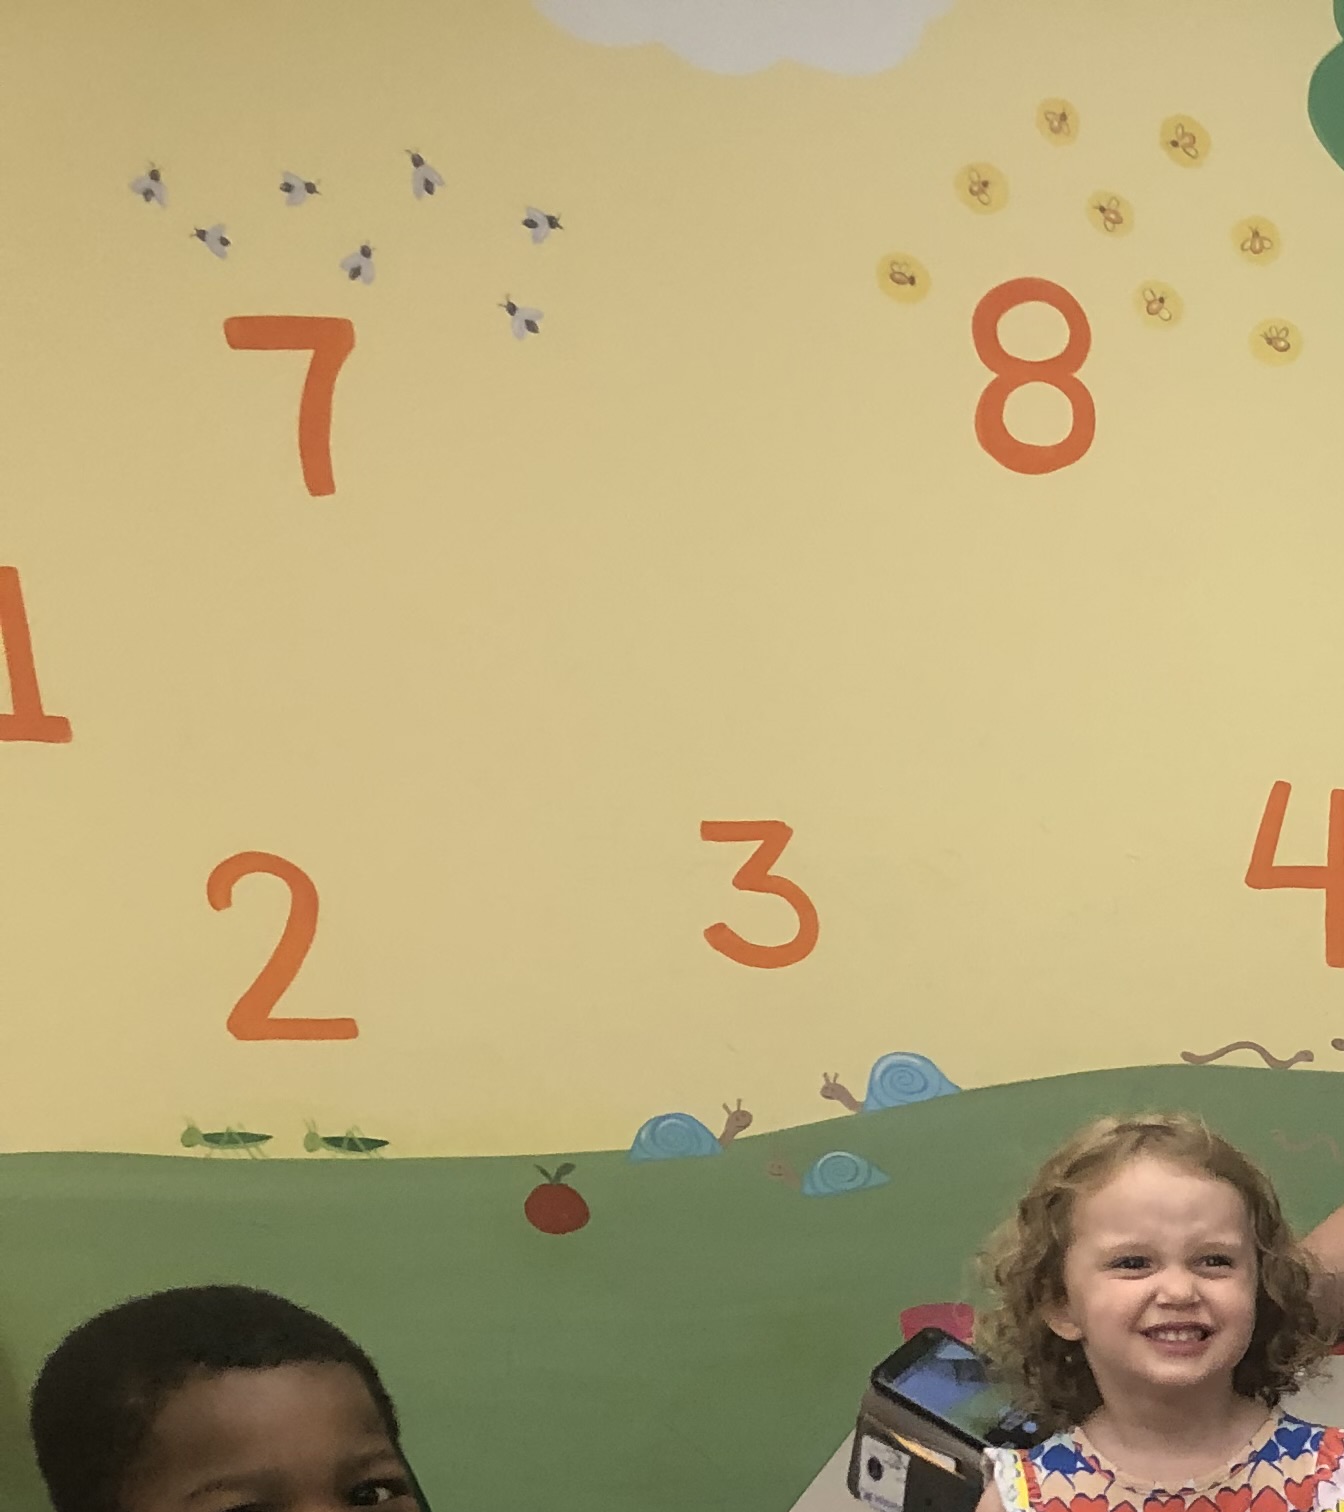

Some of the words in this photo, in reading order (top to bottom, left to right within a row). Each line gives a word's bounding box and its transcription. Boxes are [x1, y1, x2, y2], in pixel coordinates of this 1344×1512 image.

[223, 315, 355, 497] 7
[972, 277, 1096, 475] 8
[0, 565, 72, 743] 1
[207, 851, 358, 1041] 2
[700, 820, 819, 969] 3
